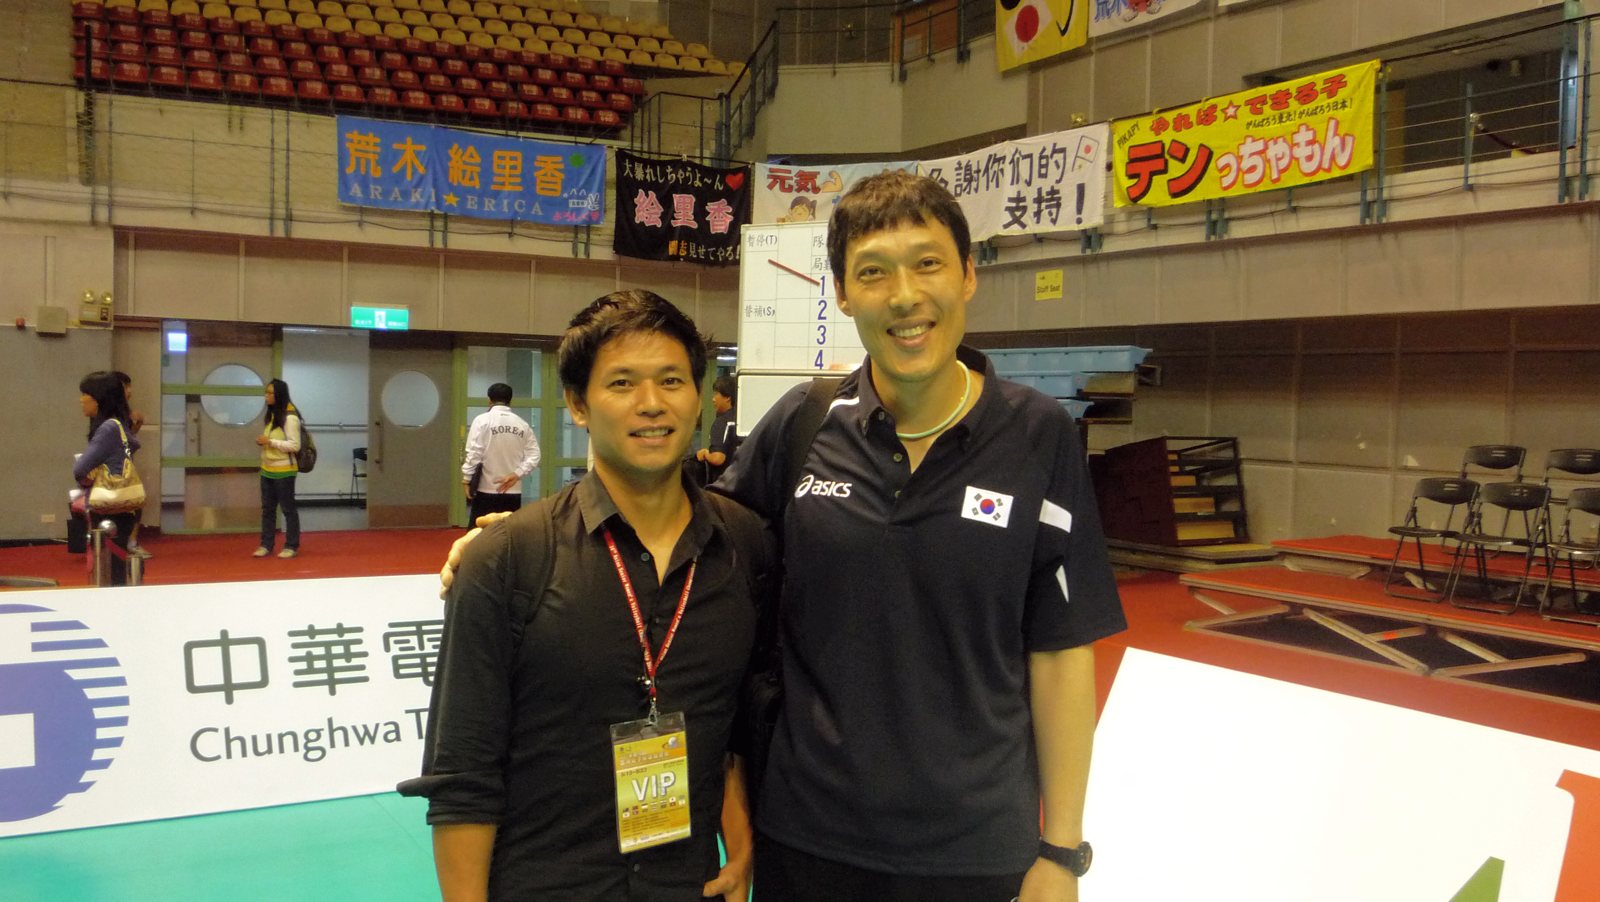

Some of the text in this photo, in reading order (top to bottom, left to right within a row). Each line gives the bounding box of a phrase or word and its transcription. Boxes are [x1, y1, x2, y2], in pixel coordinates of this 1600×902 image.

[345, 130, 565, 197] 荒木 絵里香
[350, 183, 543, 215] ARAKI ERICA
[633, 188, 734, 234] 絵里香
[1002, 183, 1086, 230] 支持!
[820, 275, 826, 296] 1
[817, 300, 827, 320] 2
[816, 325, 827, 345] 3
[814, 350, 824, 370] 4
[490, 425, 525, 438] KOREA
[190, 716, 402, 763] Chunghwa
[631, 771, 676, 801] VIP
